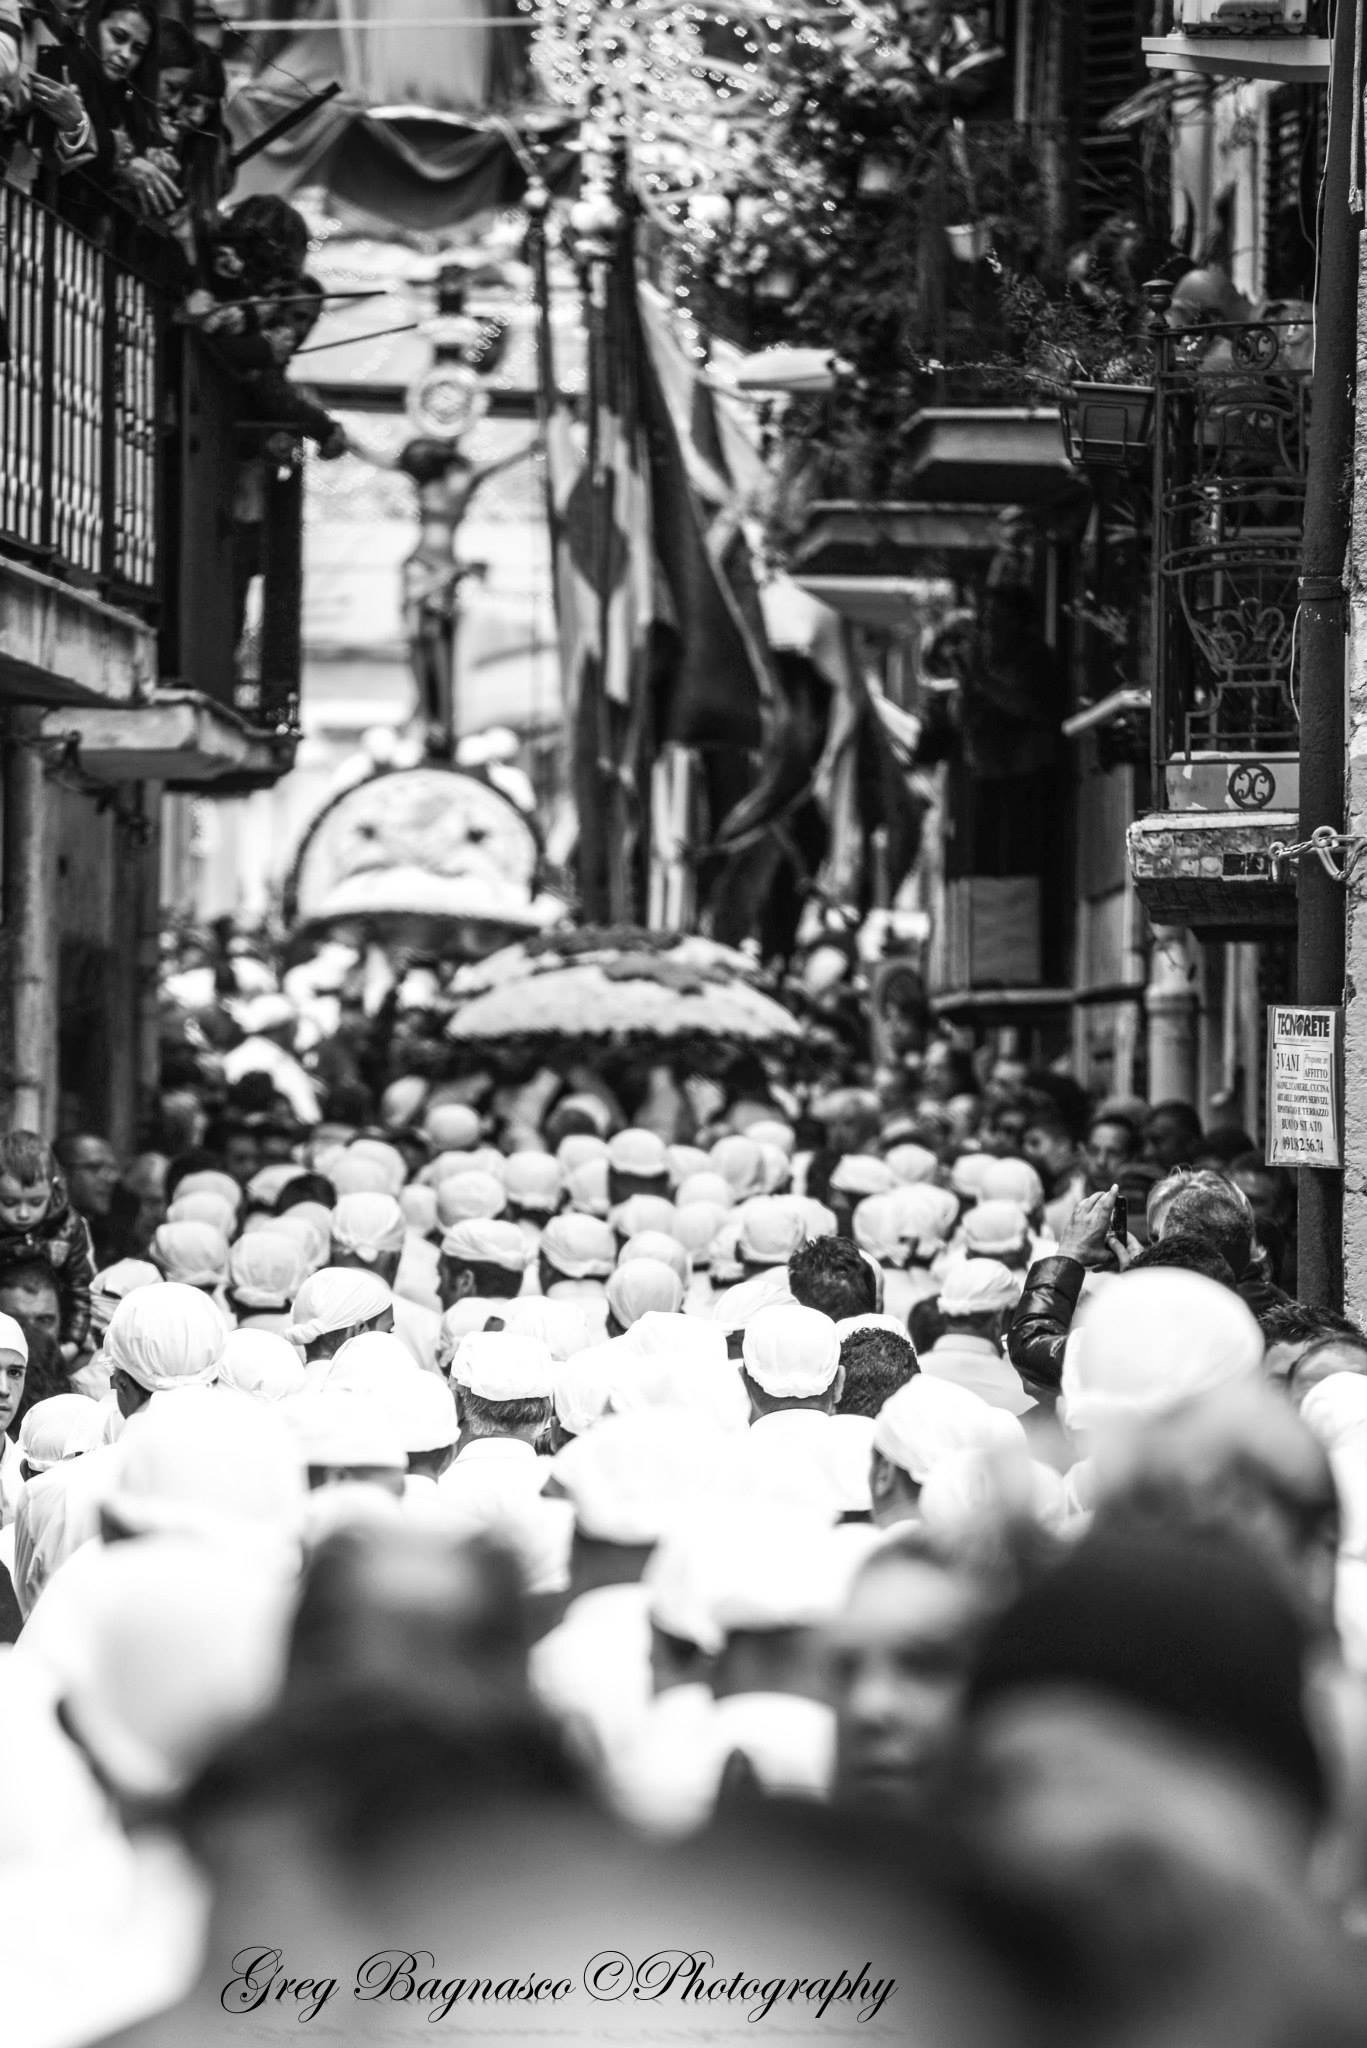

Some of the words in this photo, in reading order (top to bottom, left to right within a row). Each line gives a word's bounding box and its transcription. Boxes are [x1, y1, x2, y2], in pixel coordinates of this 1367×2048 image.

[1277, 1013, 1330, 1038] TECNORETE
[1281, 1053, 1300, 1072] VANI
[1304, 1068, 1328, 1079] AFFITTO
